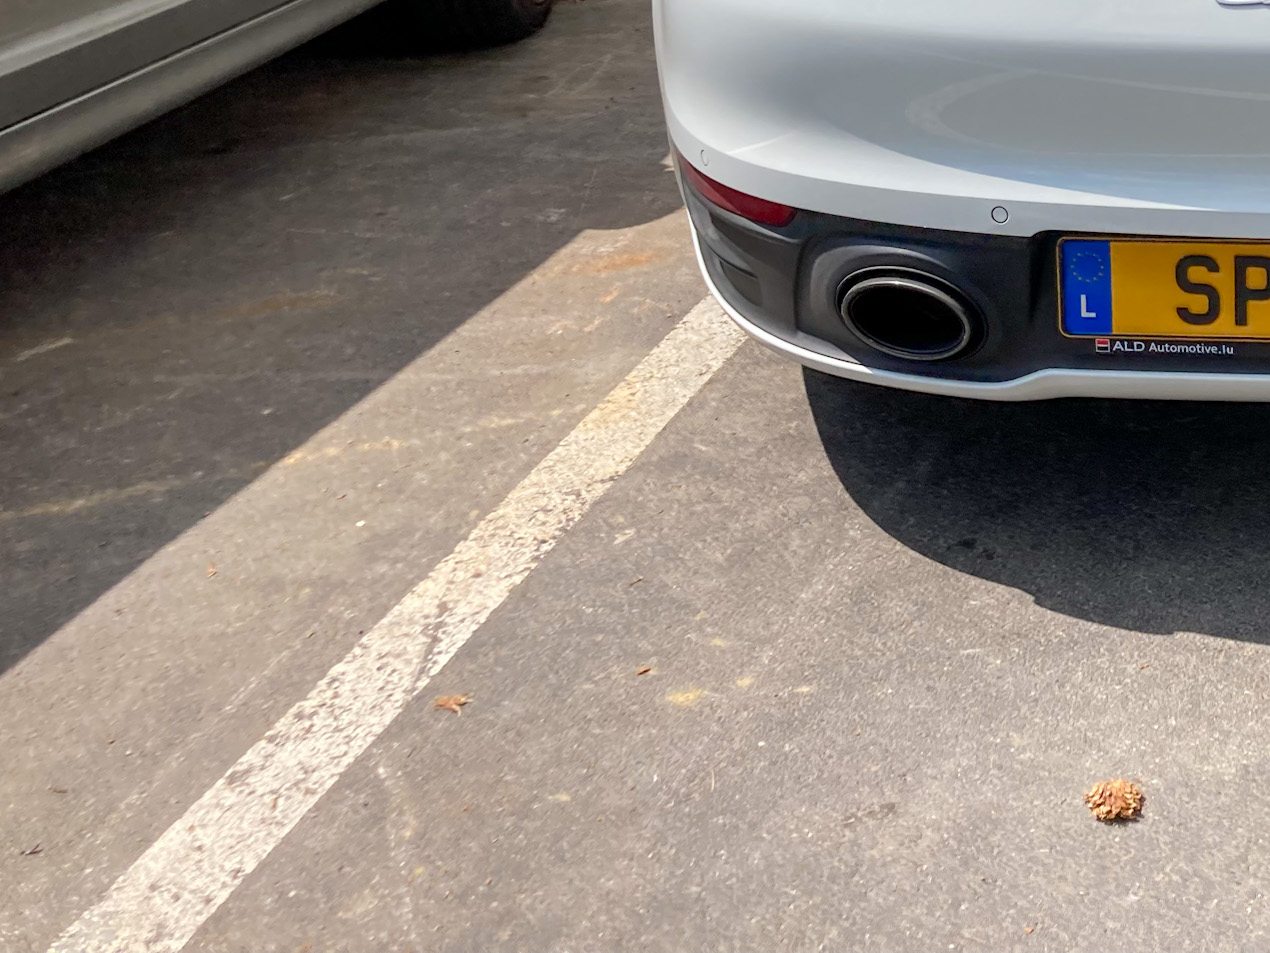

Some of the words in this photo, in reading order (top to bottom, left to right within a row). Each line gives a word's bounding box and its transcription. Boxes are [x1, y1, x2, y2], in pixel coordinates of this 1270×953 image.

[1080, 294, 1096, 319] L
[1113, 340, 1145, 352] ALD
[1149, 341, 1234, 355] Automotive.lu
